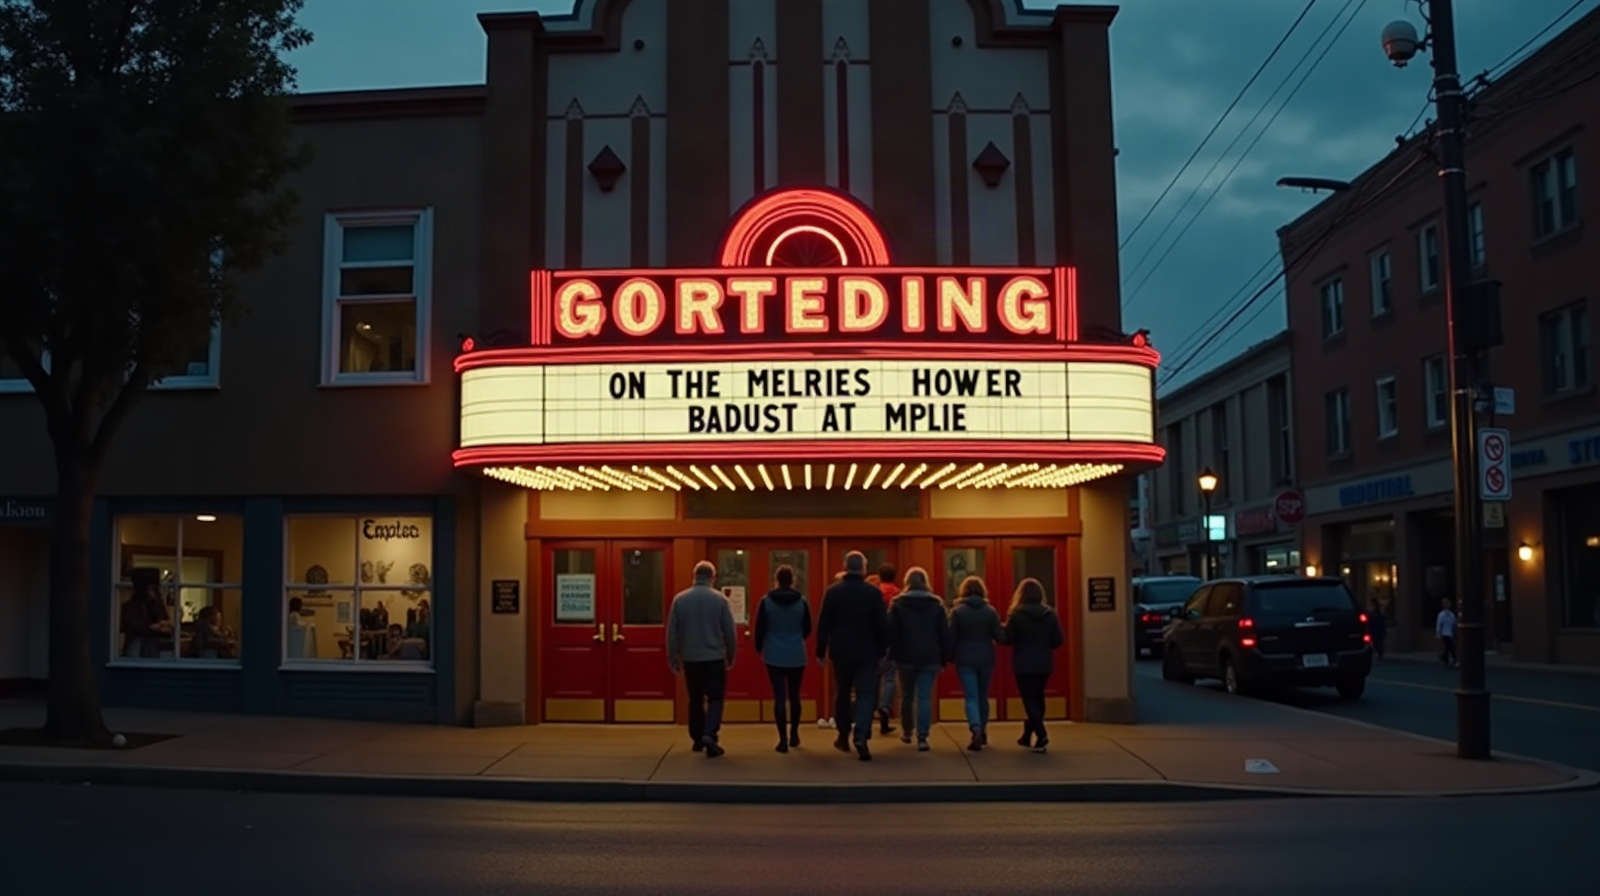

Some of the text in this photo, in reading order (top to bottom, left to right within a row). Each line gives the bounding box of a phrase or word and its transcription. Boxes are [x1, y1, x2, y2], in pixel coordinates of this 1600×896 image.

[554, 276, 1052, 337] GORTEDING
[609, 368, 1022, 400] ON THE MELRIES HOWER
[688, 403, 966, 433] BADUST AT MPLIE
